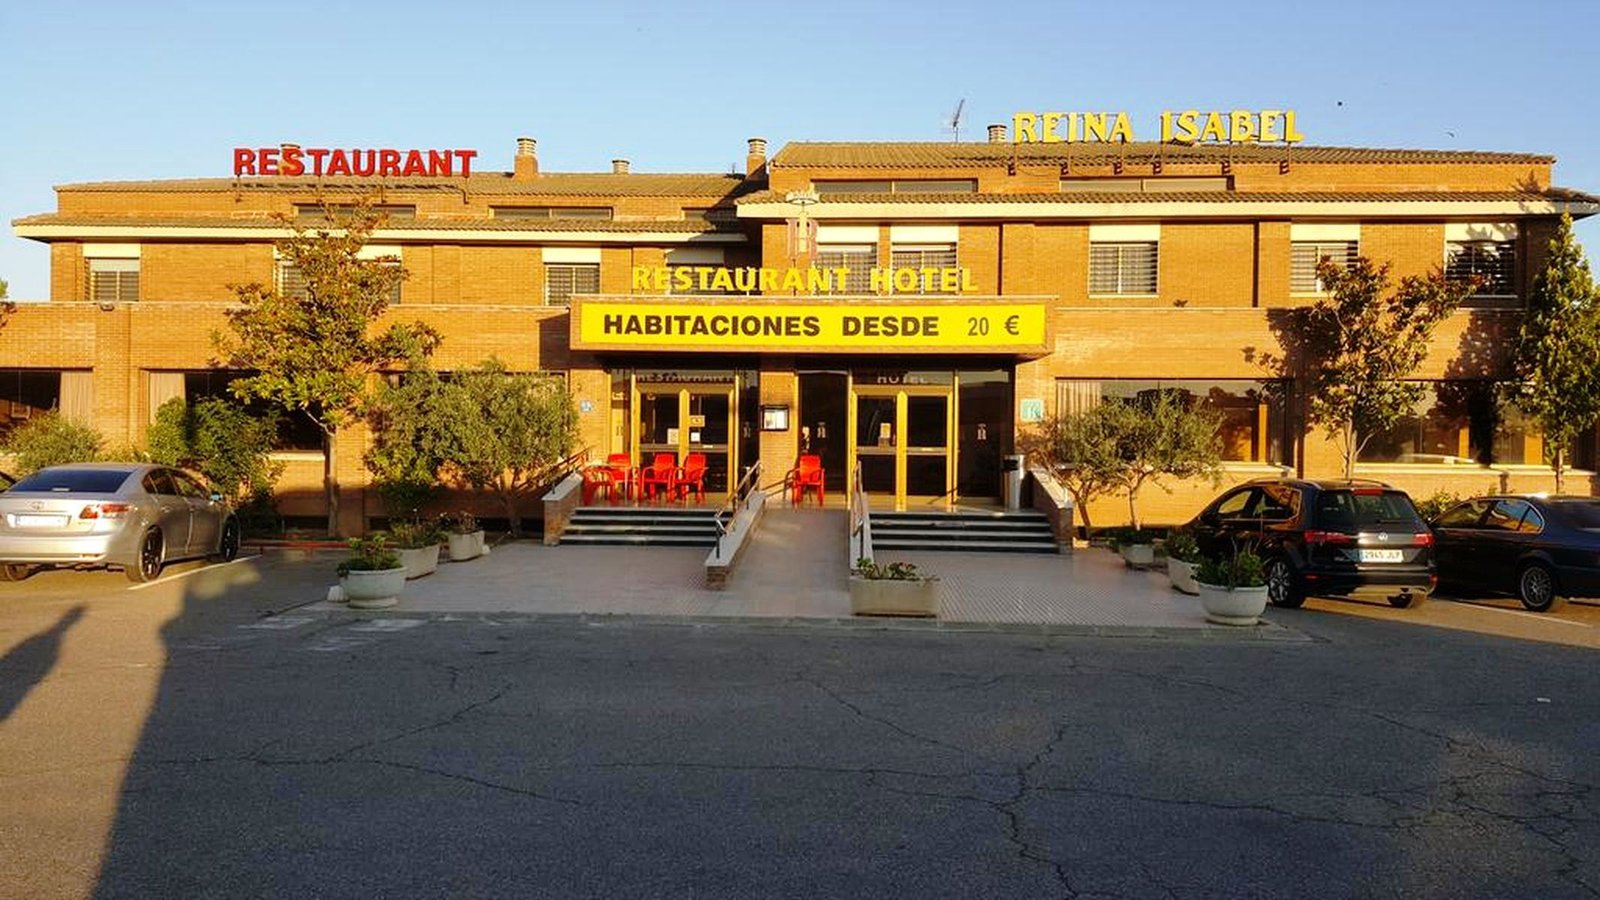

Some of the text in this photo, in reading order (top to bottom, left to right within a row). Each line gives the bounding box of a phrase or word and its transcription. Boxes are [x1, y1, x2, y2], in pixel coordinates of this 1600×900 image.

[1012, 109, 1305, 143] REINA ISABEL
[233, 148, 477, 177] RESTAURANT
[632, 265, 979, 292] RESTAURANT HOTEL
[603, 314, 1020, 337] HABITACIONES DESDE 20 €
